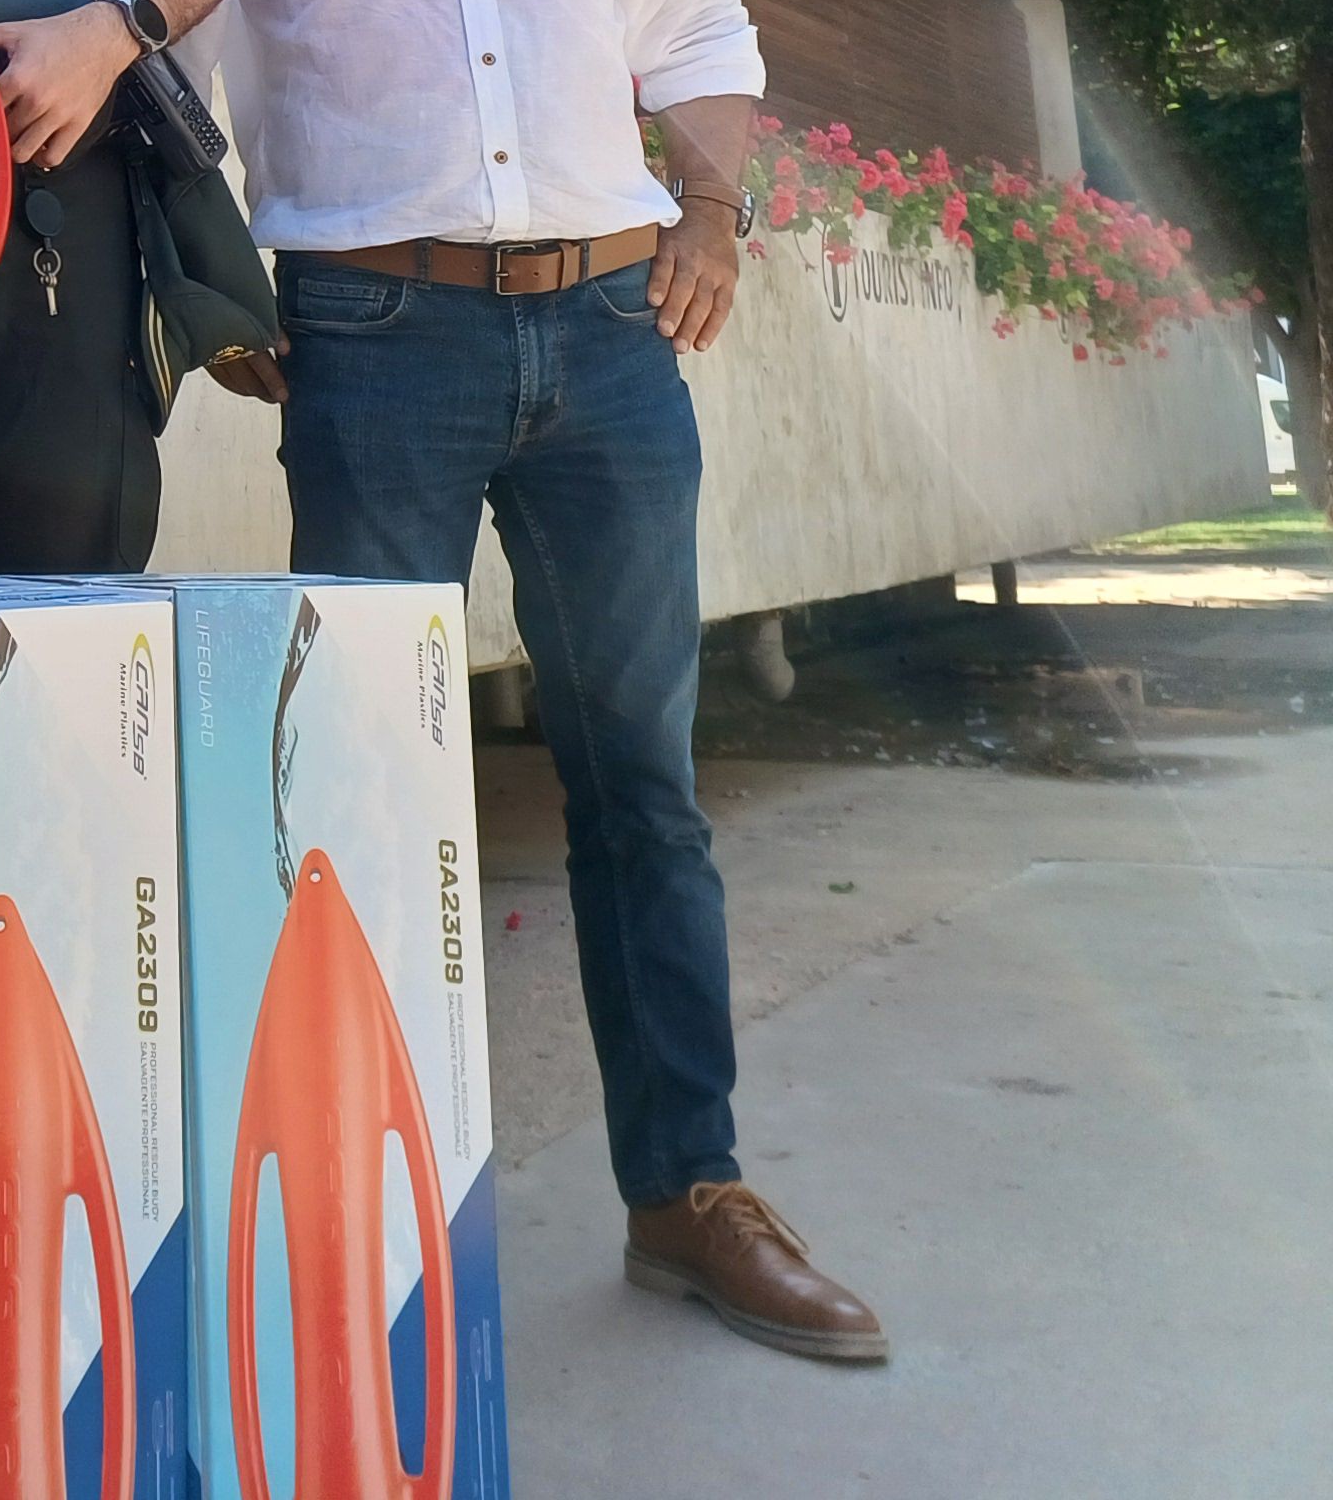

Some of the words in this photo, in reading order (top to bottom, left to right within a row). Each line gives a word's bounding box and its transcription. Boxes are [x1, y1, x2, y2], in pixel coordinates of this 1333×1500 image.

[119, 662, 128, 707] Marine
[195, 609, 213, 748] LIFEGUARD
[120, 710, 129, 758] Plastics
[136, 876, 158, 1033] GA2309
[438, 839, 464, 985] GA2309
[139, 1040, 149, 1117] SALVAGENTE
[150, 1041, 159, 1135] PROFESSIONAL
[141, 1119, 150, 1221] PROFESSIONALE
[151, 1137, 159, 1188] RESCUE
